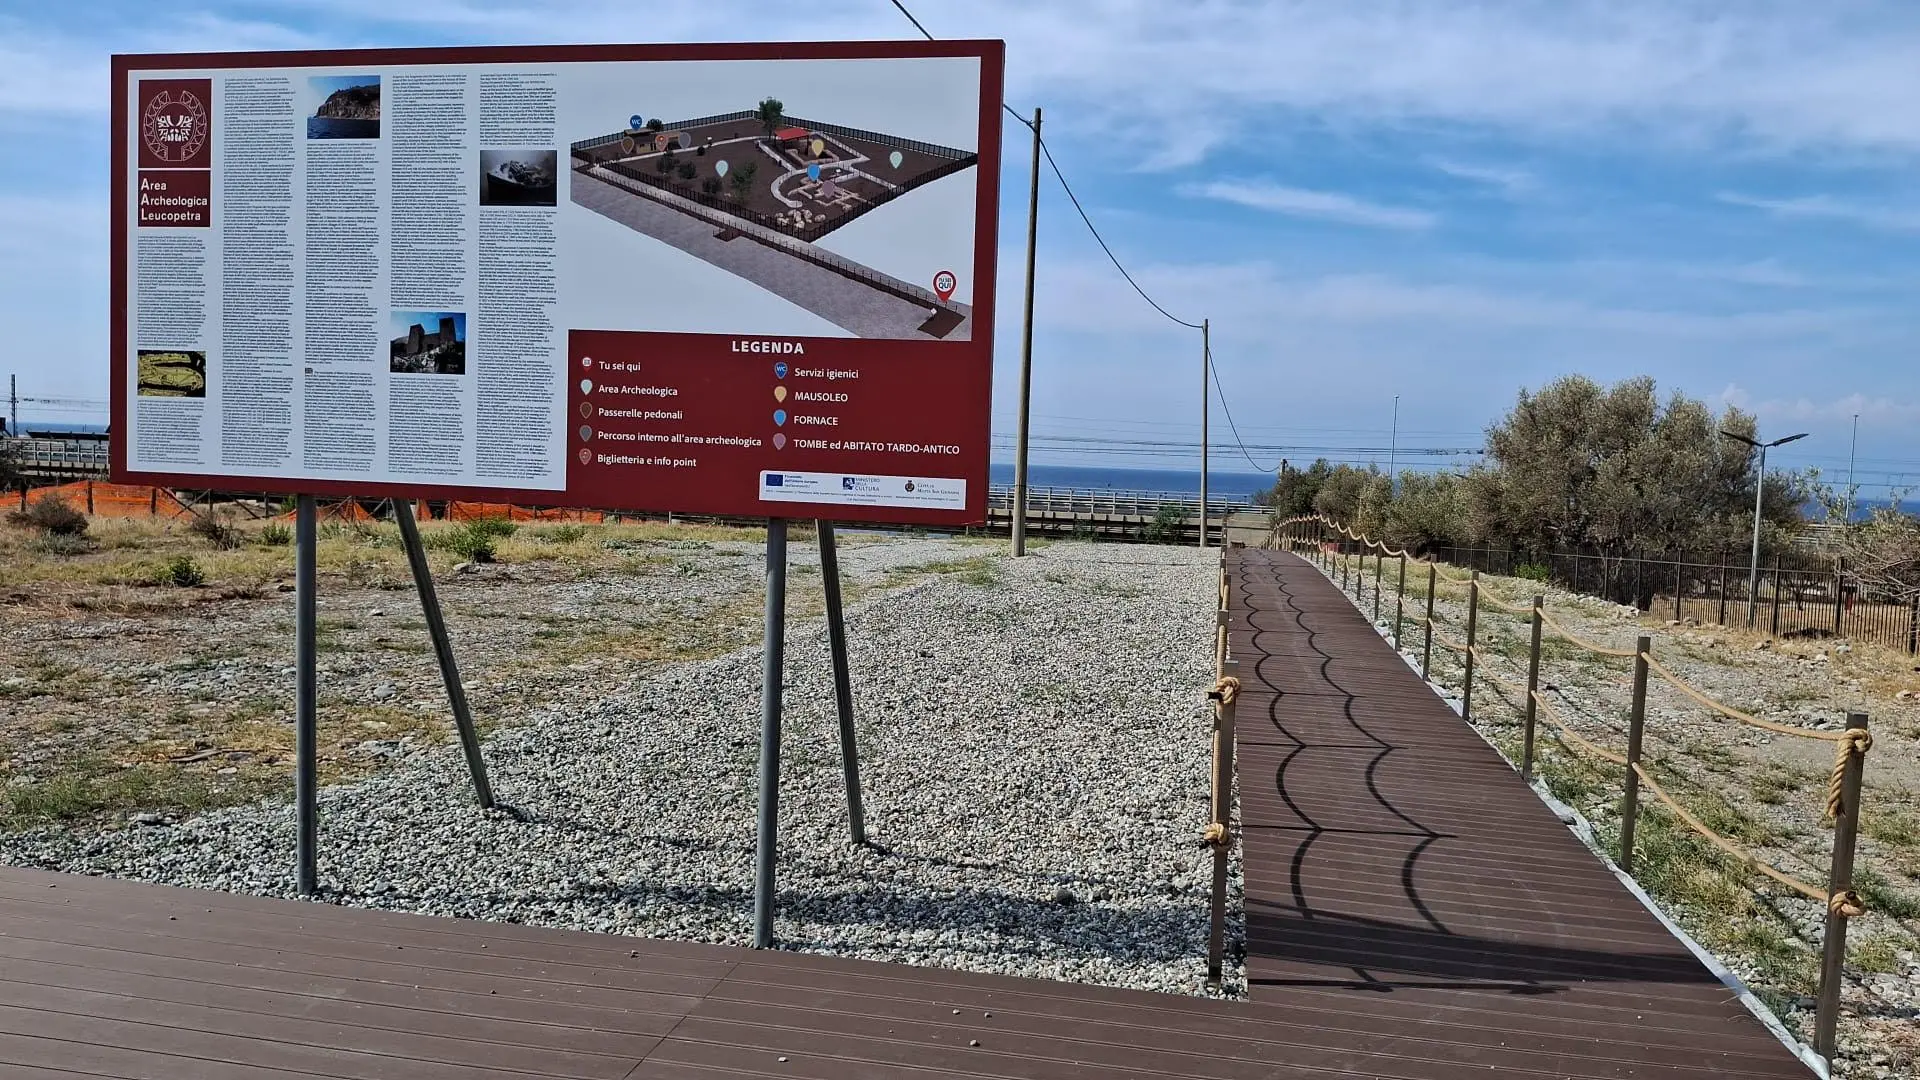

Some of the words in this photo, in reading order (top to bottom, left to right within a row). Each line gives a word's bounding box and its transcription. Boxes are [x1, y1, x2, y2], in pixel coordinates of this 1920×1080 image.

[141, 178, 167, 191] Area
[141, 194, 208, 207] Archeologica
[141, 208, 201, 222] Leucopetra
[732, 341, 804, 354] LEGENDA
[599, 361, 610, 370] Tu
[612, 362, 625, 371] sei
[626, 362, 641, 373] qui
[794, 367, 824, 378] Servizi
[826, 368, 859, 380] igienici
[598, 385, 618, 394] Area
[621, 386, 678, 398] Archeologica
[794, 392, 848, 402] MAUSOLEO
[598, 408, 642, 418] Passerelle
[644, 409, 683, 420] pedonali
[794, 415, 839, 426] FORNACE
[598, 431, 636, 442] Percorso
[638, 432, 669, 442] interno
[671, 433, 704, 444] all'area
[705, 435, 762, 448] archeologica
[794, 439, 828, 450] TOMBE
[829, 440, 841, 450] ed
[843, 441, 884, 452] ABITATO
[886, 443, 960, 455] TARDO-ANTICO
[597, 454, 644, 465] Biglietteria
[654, 456, 672, 466] info
[673, 458, 697, 468] point
